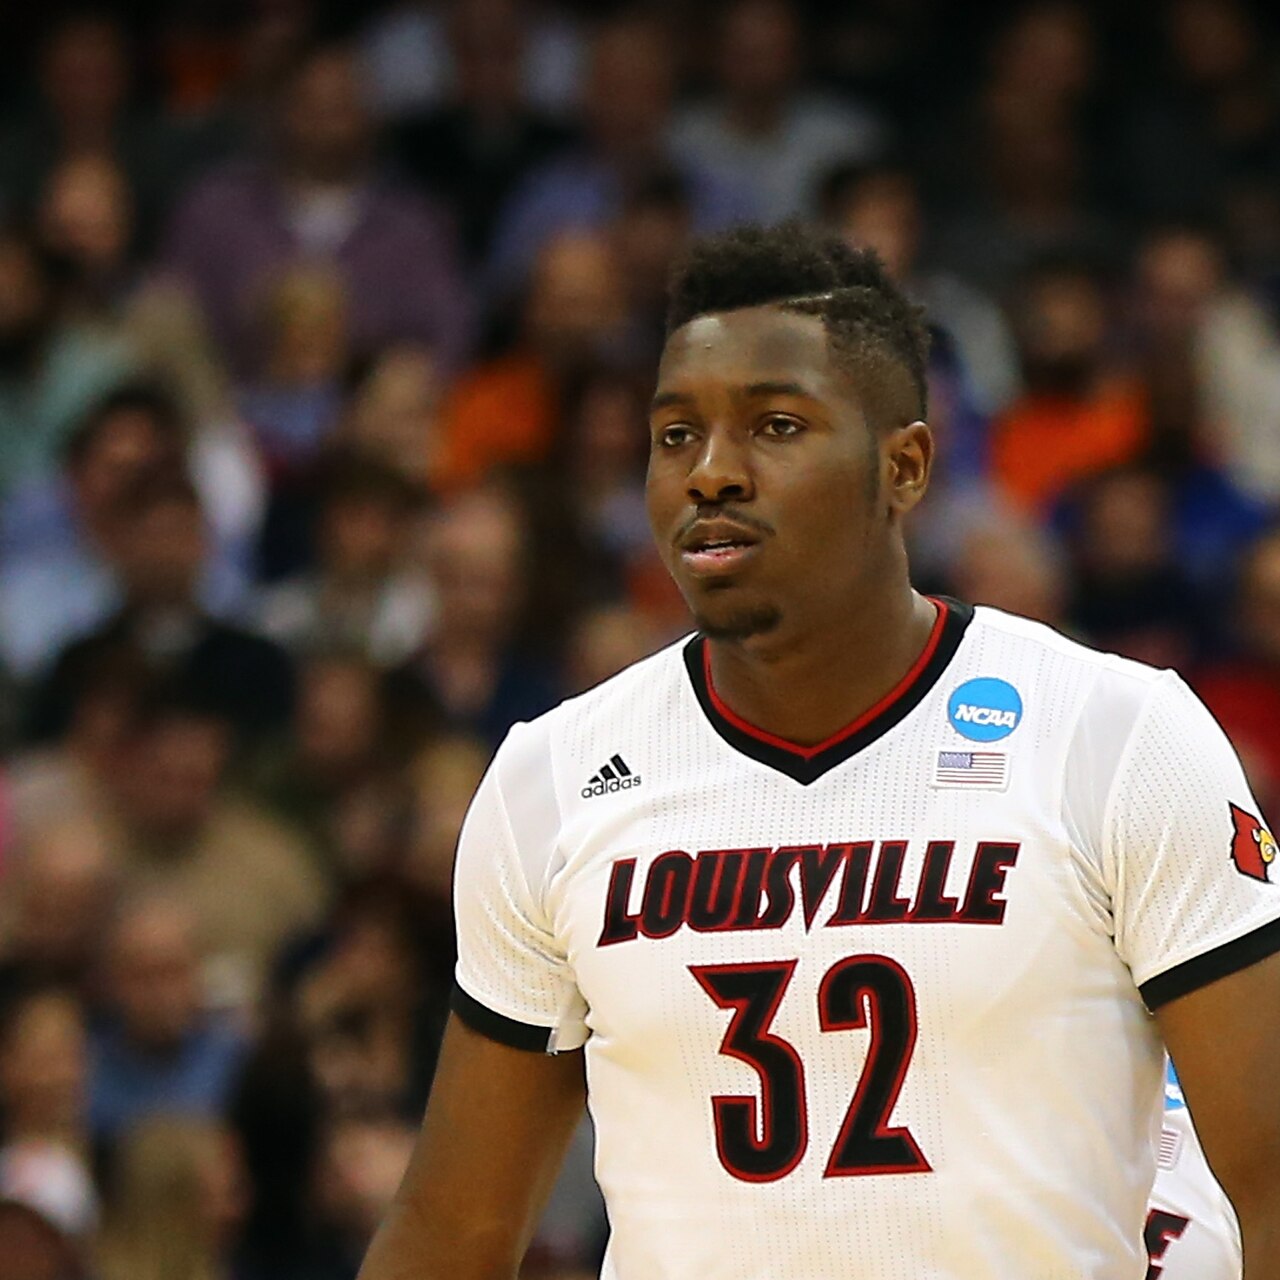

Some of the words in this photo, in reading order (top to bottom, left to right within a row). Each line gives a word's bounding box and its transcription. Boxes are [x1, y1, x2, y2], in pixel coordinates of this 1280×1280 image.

[954, 704, 1017, 729] NCAA
[581, 775, 642, 799] adidas
[597, 841, 1020, 947] LOUISVILLE
[686, 953, 934, 1183] 32
